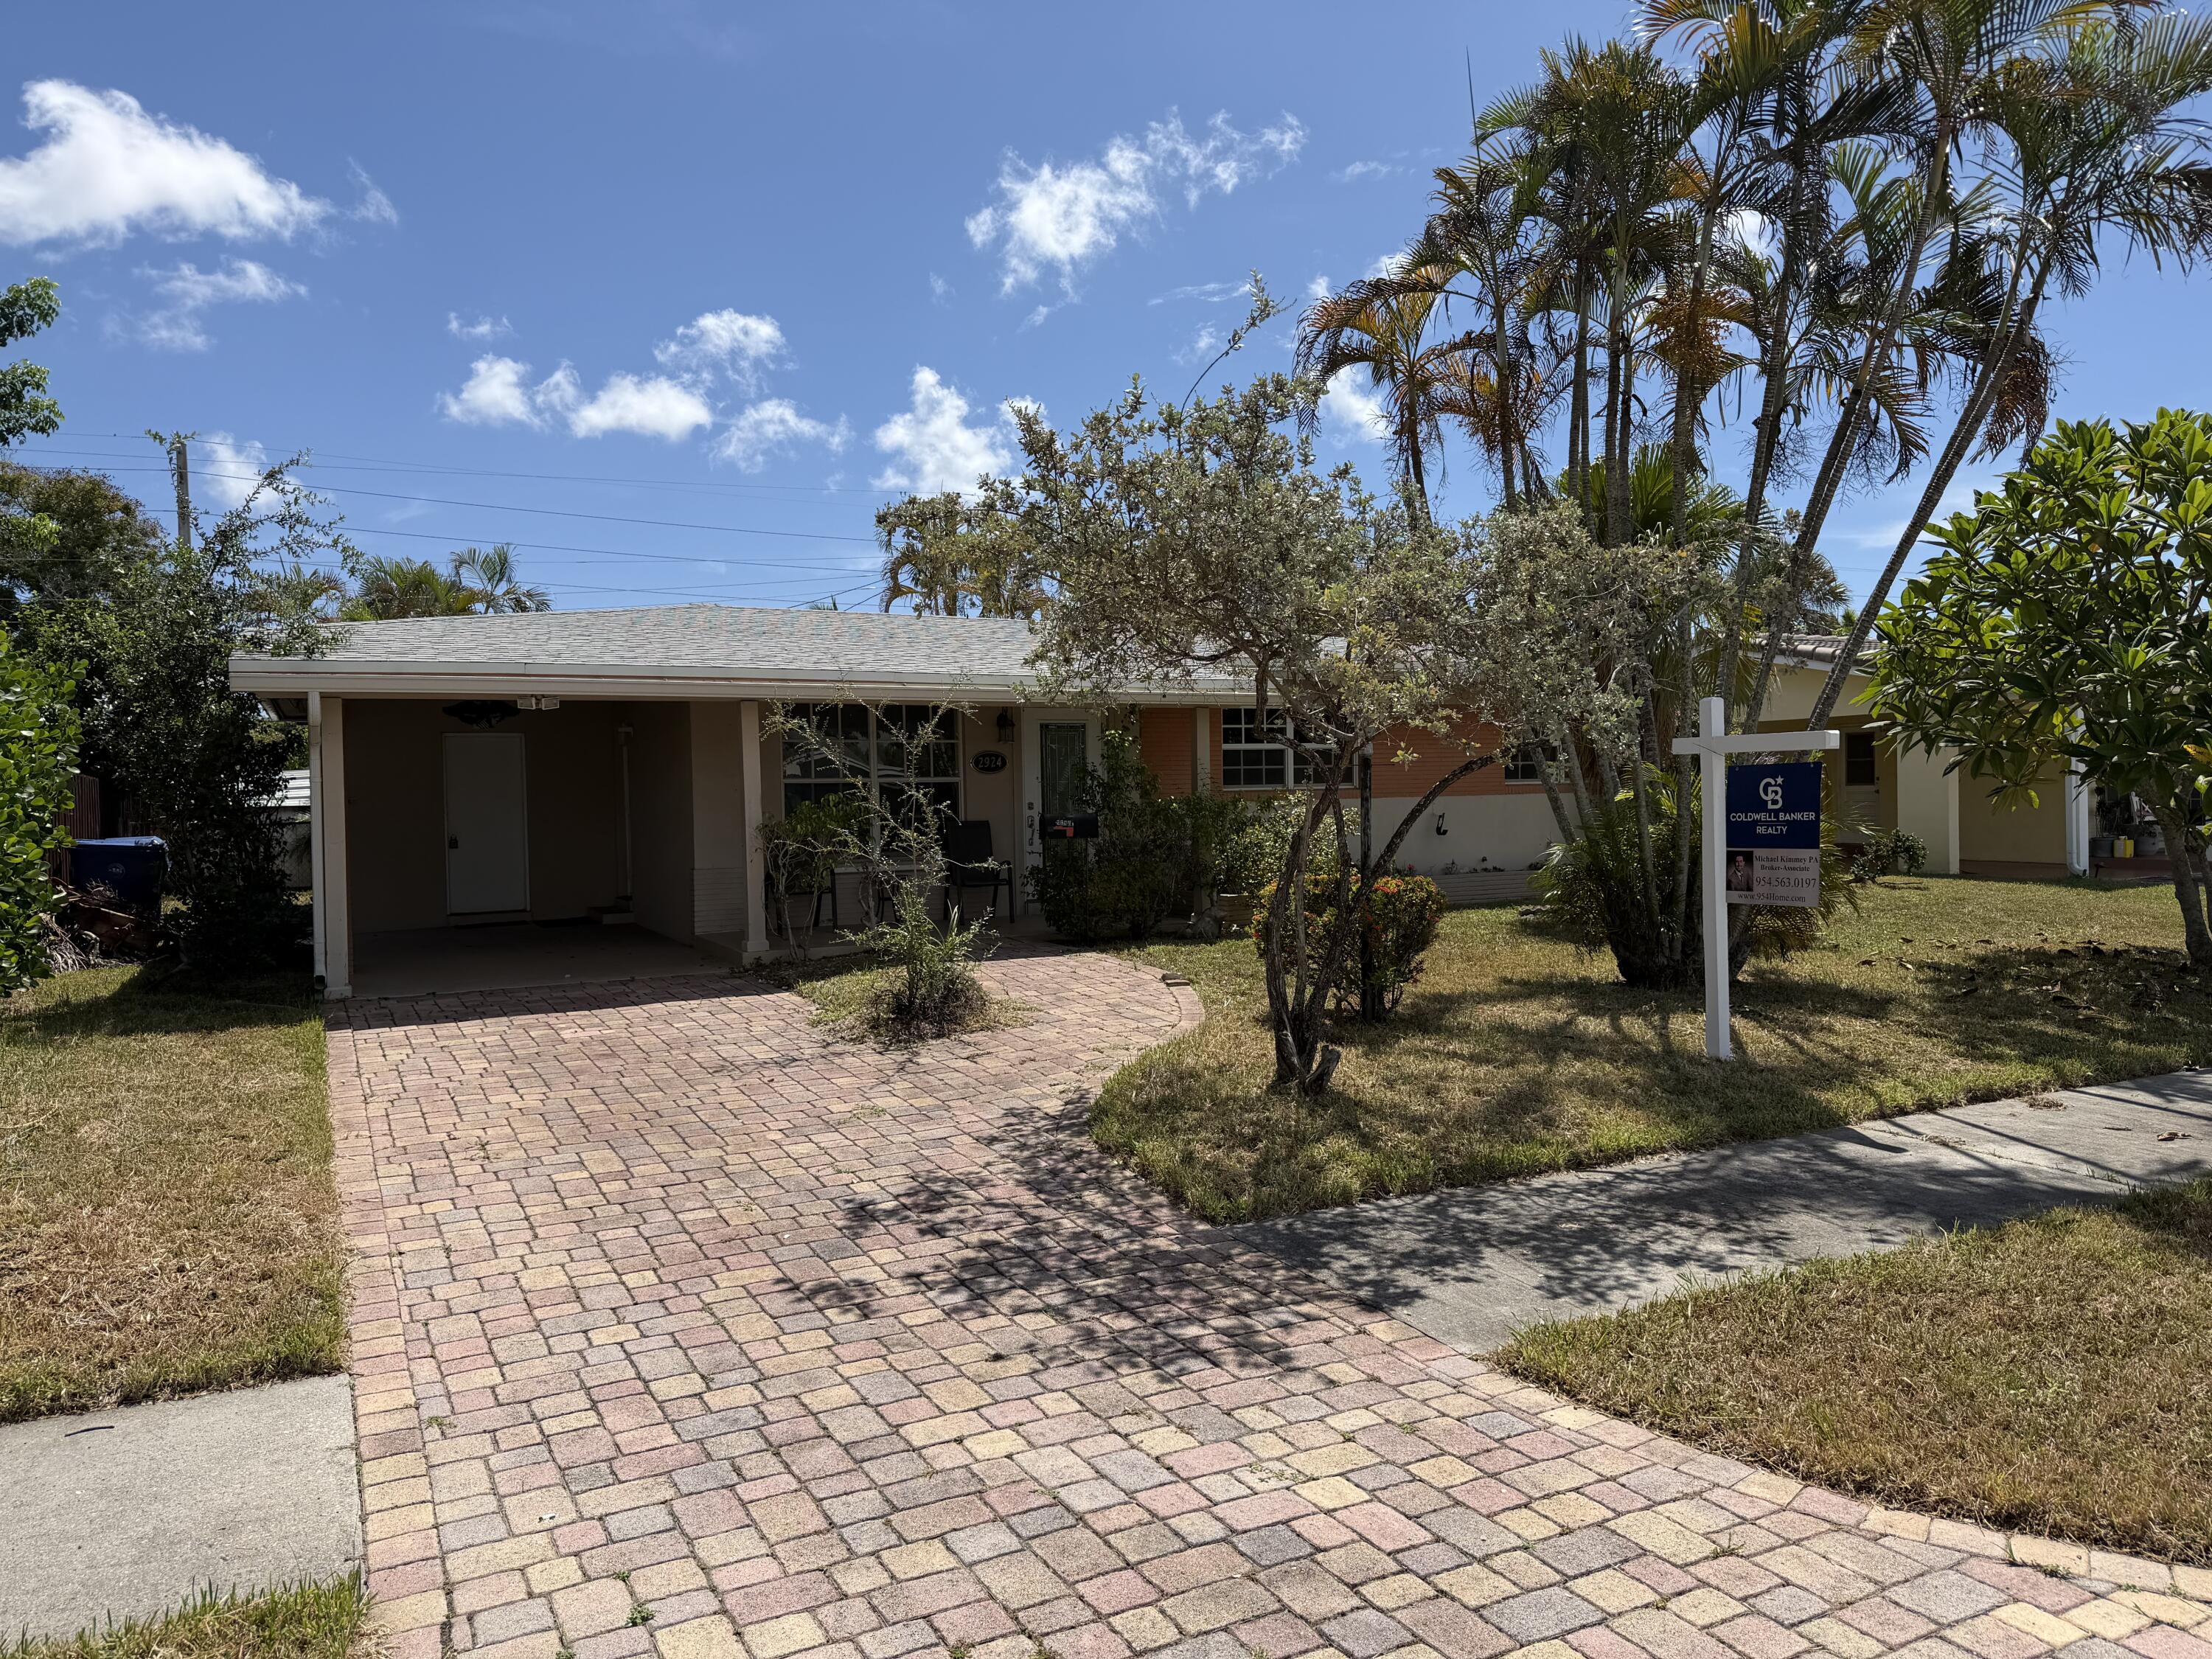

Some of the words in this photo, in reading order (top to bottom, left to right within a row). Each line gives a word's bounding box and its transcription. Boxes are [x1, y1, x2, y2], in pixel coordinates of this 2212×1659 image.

[978, 756, 1002, 768] 2924
[1730, 813, 1777, 821] COLDWELL
[1779, 812, 1815, 821] BANKER
[1756, 826, 1788, 834] REALTY
[1754, 855, 1778, 863] Michael
[1756, 876, 1816, 888] 954.563.0197
[1738, 893, 1806, 902] www.954Home.com
